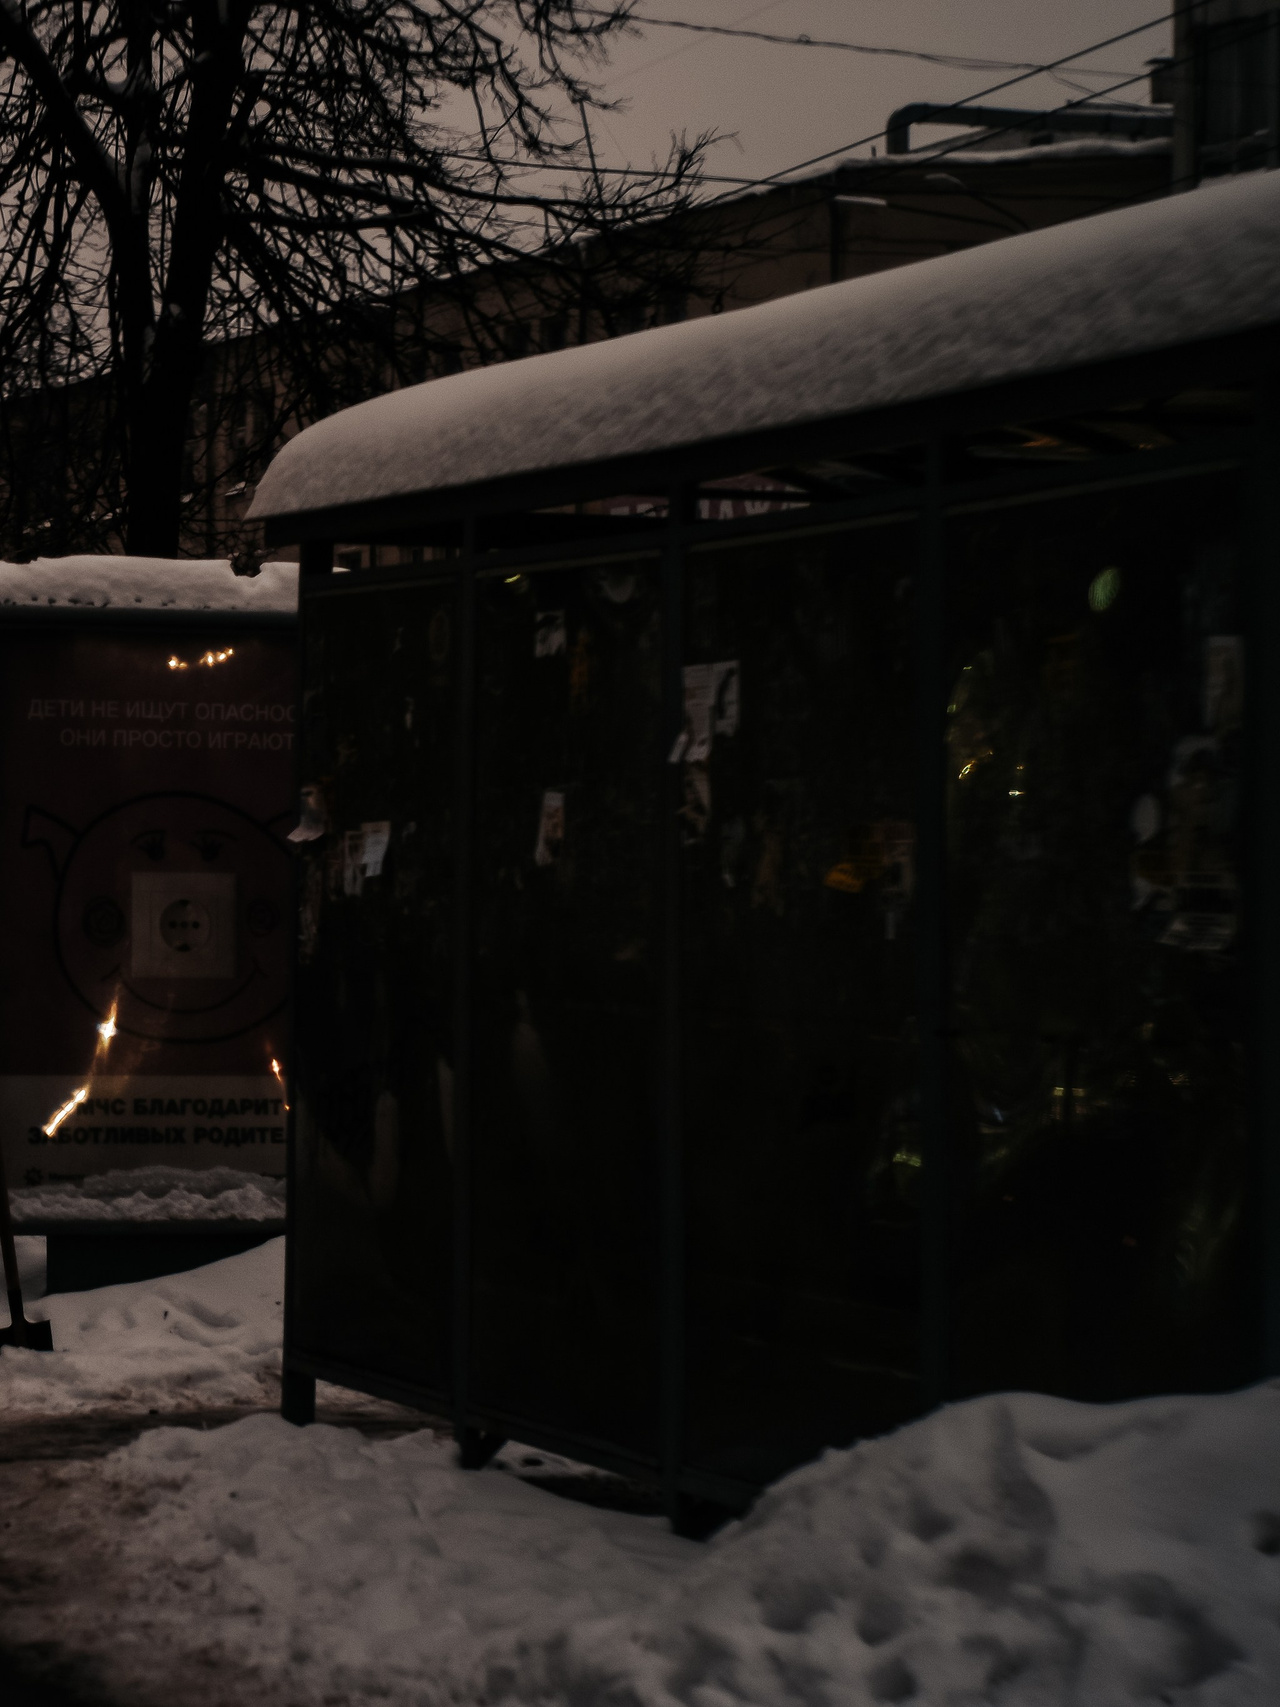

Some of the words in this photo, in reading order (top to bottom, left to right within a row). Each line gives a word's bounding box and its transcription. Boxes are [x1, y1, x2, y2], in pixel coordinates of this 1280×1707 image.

[27, 700, 84, 720] ДЕТИ
[90, 700, 120, 719] НЕ
[126, 701, 190, 723] ИЩУТ
[60, 728, 107, 747] ОНИ
[112, 729, 202, 749] ПРОСТО
[207, 731, 295, 751] ИГРАЮТ
[76, 1098, 126, 1115] МЧС
[133, 1098, 282, 1118] БЛАГОДАРИТ
[193, 1127, 288, 1147] РОДИТЕ
